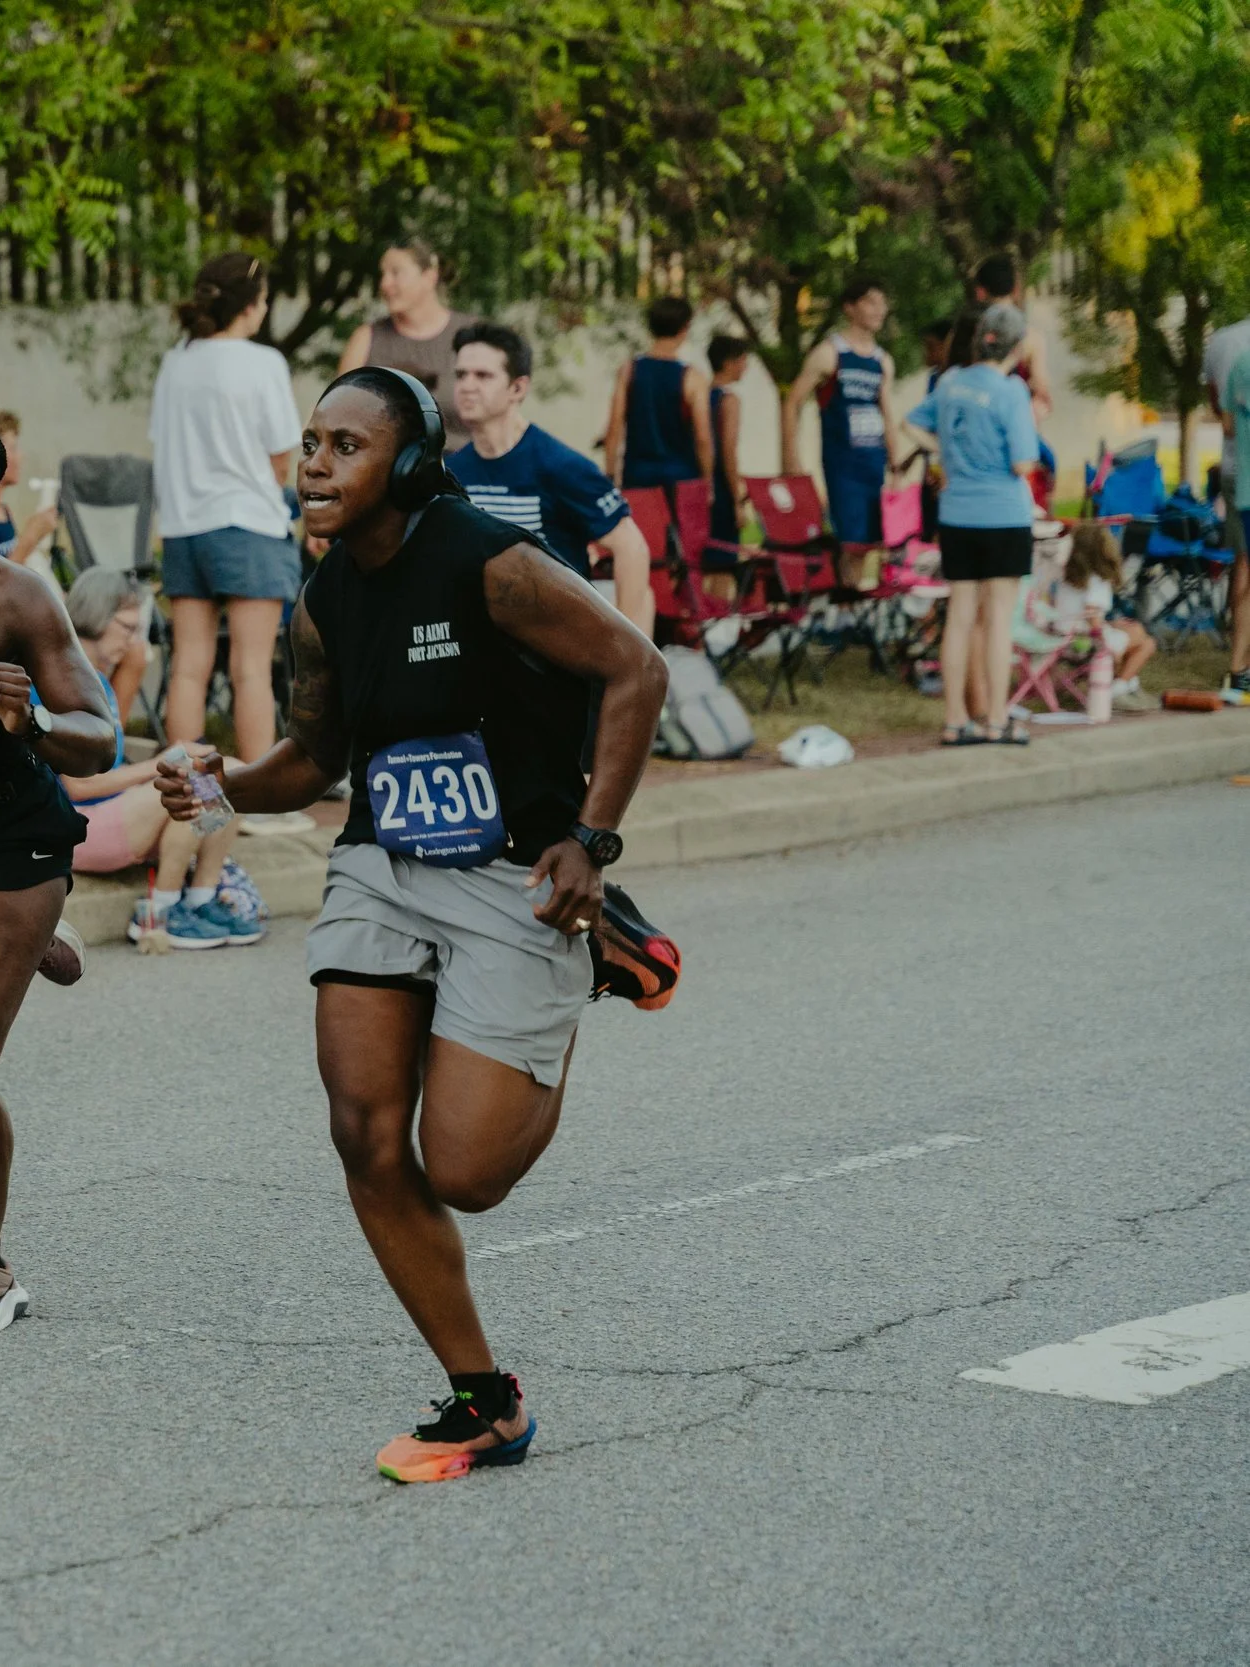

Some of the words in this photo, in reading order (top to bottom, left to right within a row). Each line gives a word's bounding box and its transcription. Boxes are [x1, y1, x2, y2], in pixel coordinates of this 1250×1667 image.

[413, 625, 425, 644] US
[425, 621, 450, 642] ARMY
[372, 763, 497, 830] 2430
[423, 847, 458, 857] Lexington
[457, 843, 481, 853] Health
